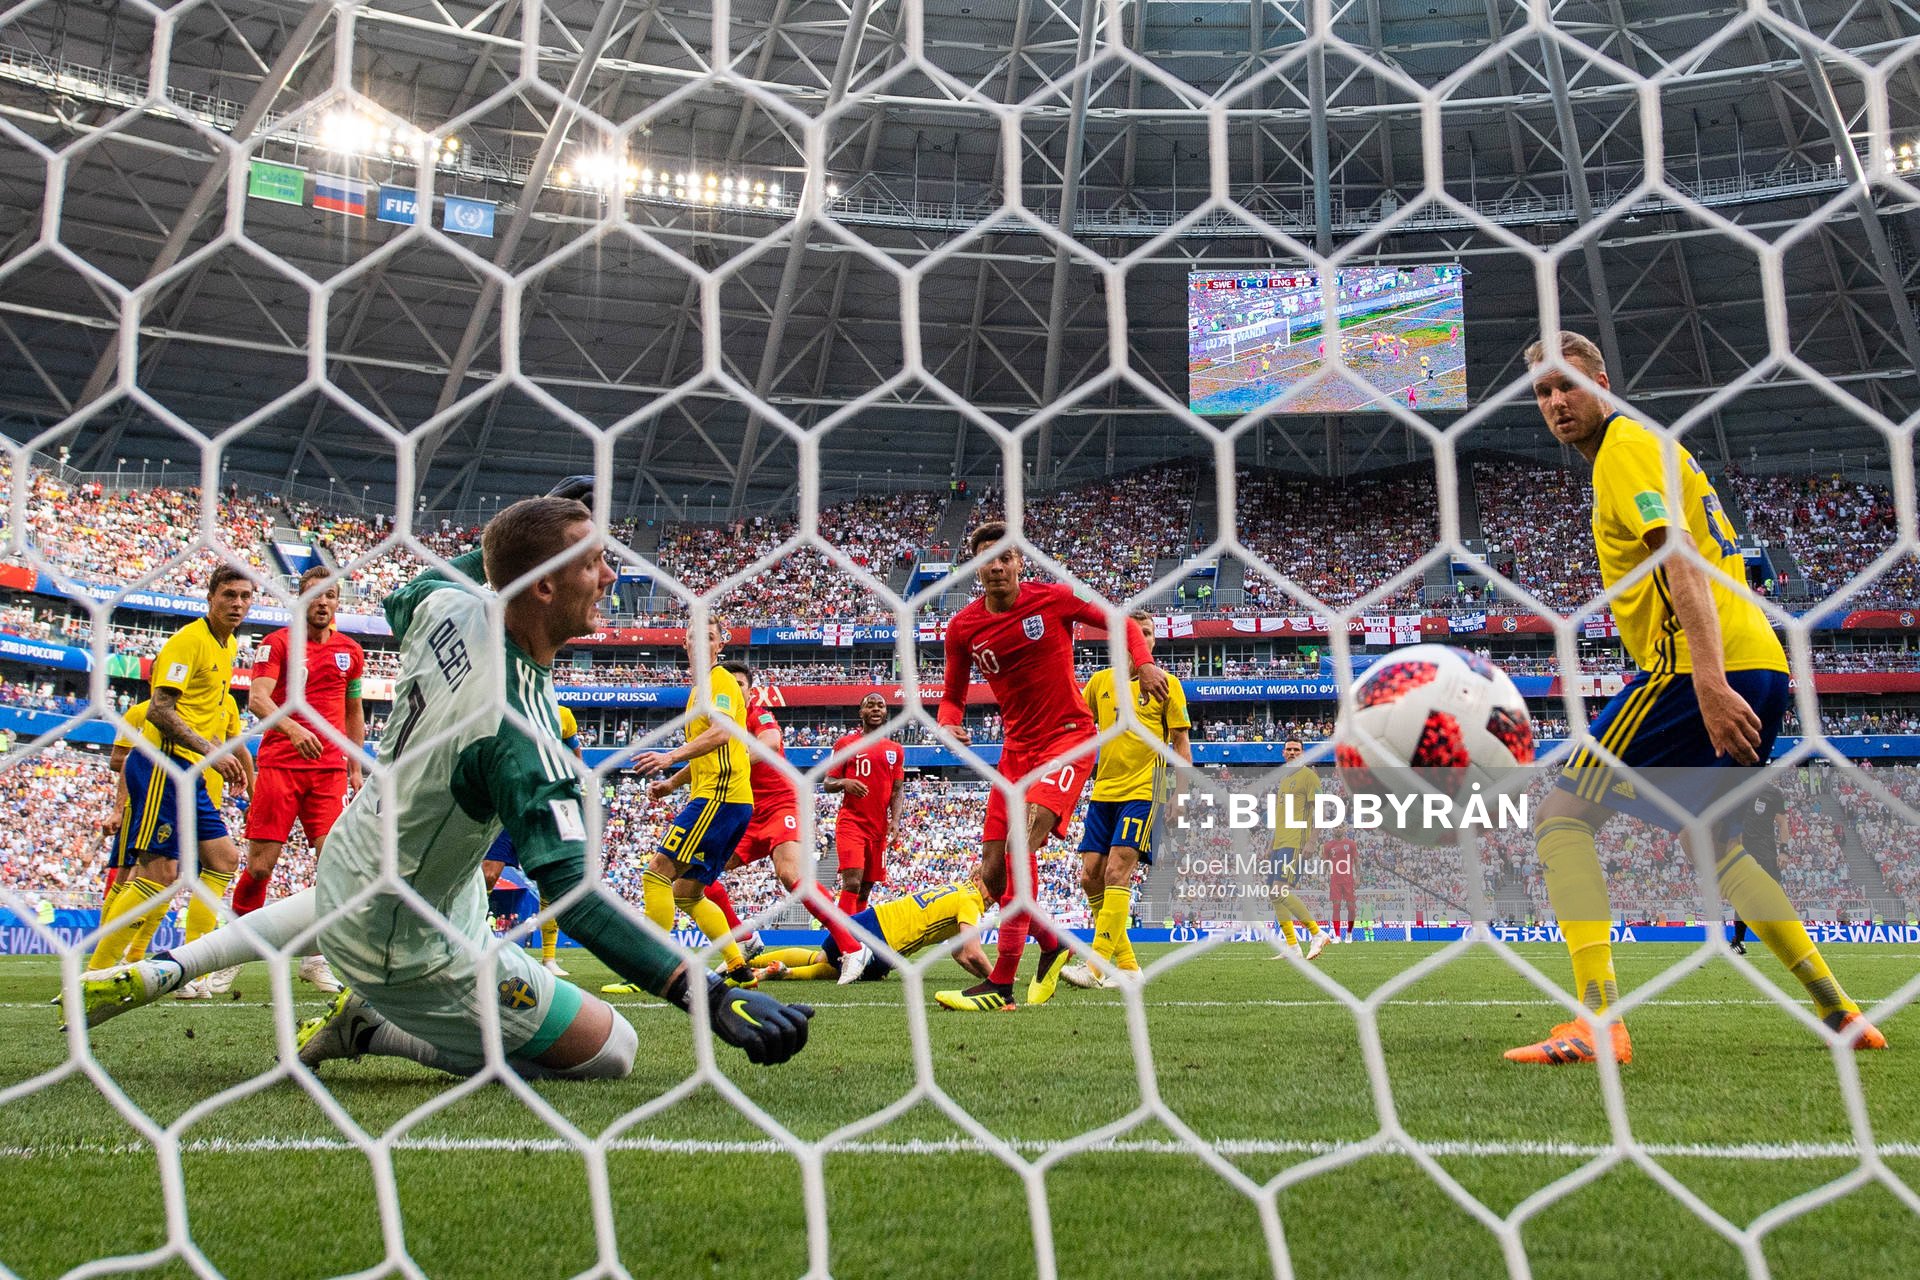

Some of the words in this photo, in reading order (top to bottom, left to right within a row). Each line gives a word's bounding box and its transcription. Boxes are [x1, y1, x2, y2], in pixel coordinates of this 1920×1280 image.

[1212, 281, 1232, 289] SWE
[1241, 280, 1247, 288] 0
[1257, 279, 1263, 287] 0
[1272, 278, 1291, 287] ENG
[155, 596, 171, 609] ПО
[172, 600, 209, 613] ФУТБО
[874, 630, 890, 640] ПО
[1371, 625, 1415, 633] EASTWOOD
[1465, 624, 1483, 632] TOUR
[428, 617, 473, 694] OLSEN
[592, 692, 616, 702] CUP
[617, 691, 657, 702] RUSSIA
[1196, 686, 1263, 696] ЧЕМПИОНАТ
[1267, 685, 1299, 695] МИРА
[1301, 685, 1316, 694] ПО
[855, 757, 871, 777] 10
[1121, 816, 1144, 843] 17
[1495, 926, 1547, 943] 万达
[1548, 926, 1637, 943] WDA
[1848, 925, 1920, 943] WAND
